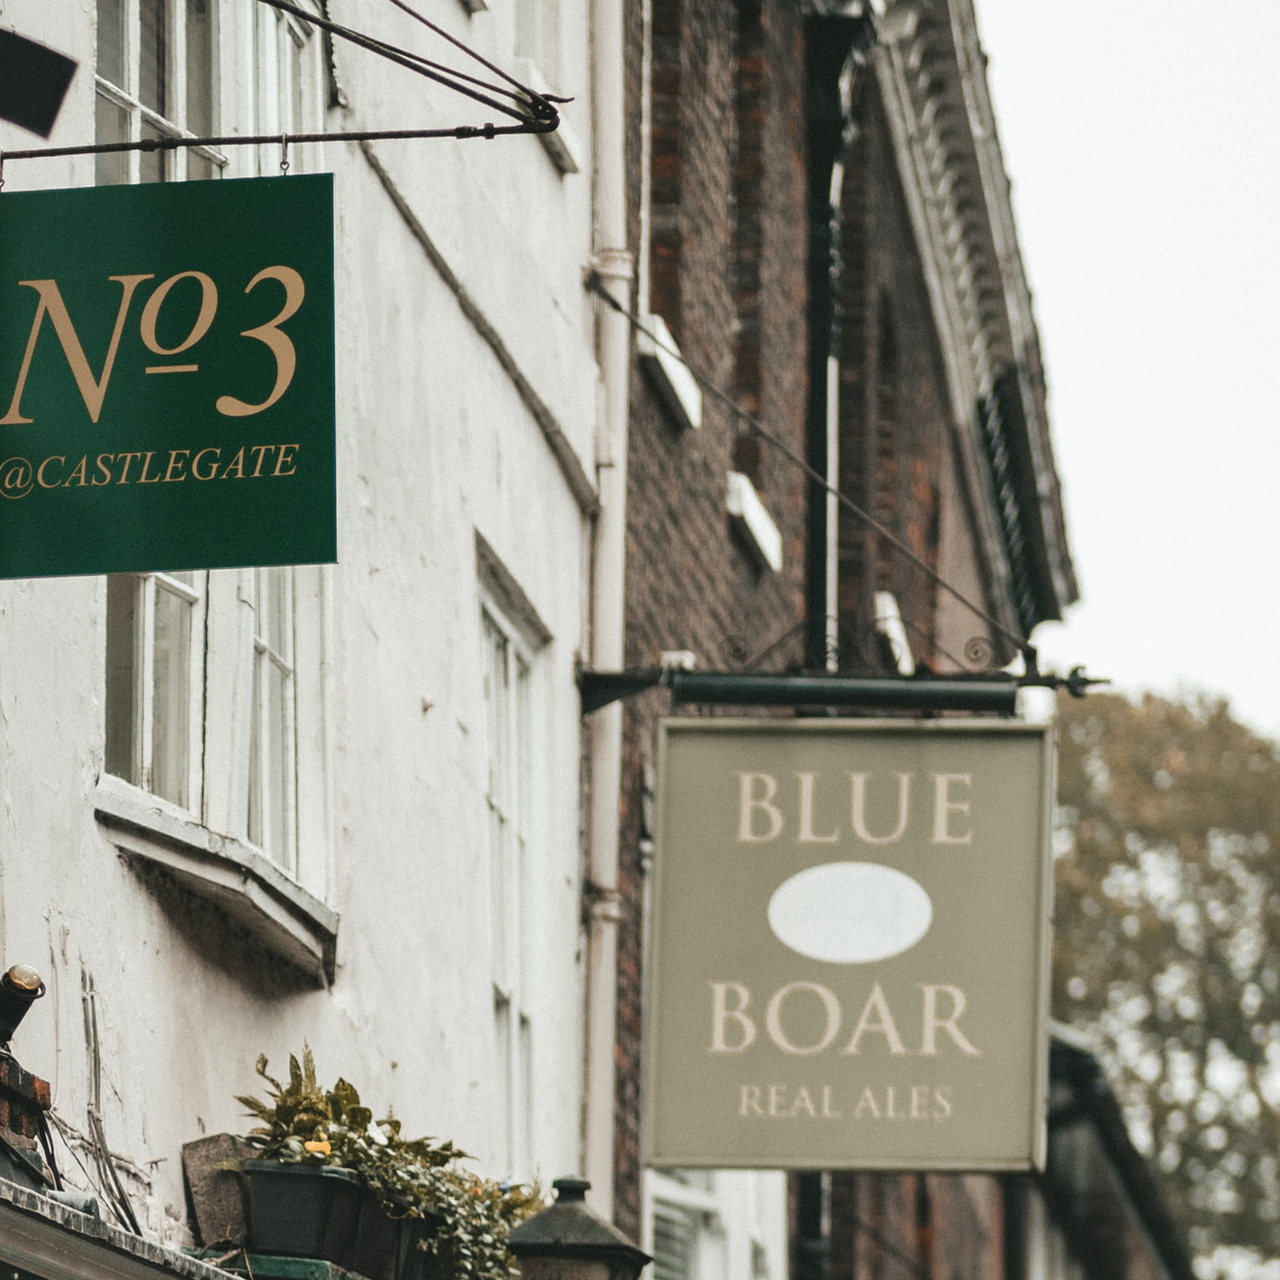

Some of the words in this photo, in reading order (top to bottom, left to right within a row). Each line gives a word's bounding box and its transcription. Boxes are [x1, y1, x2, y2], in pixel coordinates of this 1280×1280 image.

[734, 770, 974, 846] BLUE
[707, 979, 983, 1058] BOAR
[738, 1083, 844, 1119] REAL
[852, 1083, 955, 1120] ALES
